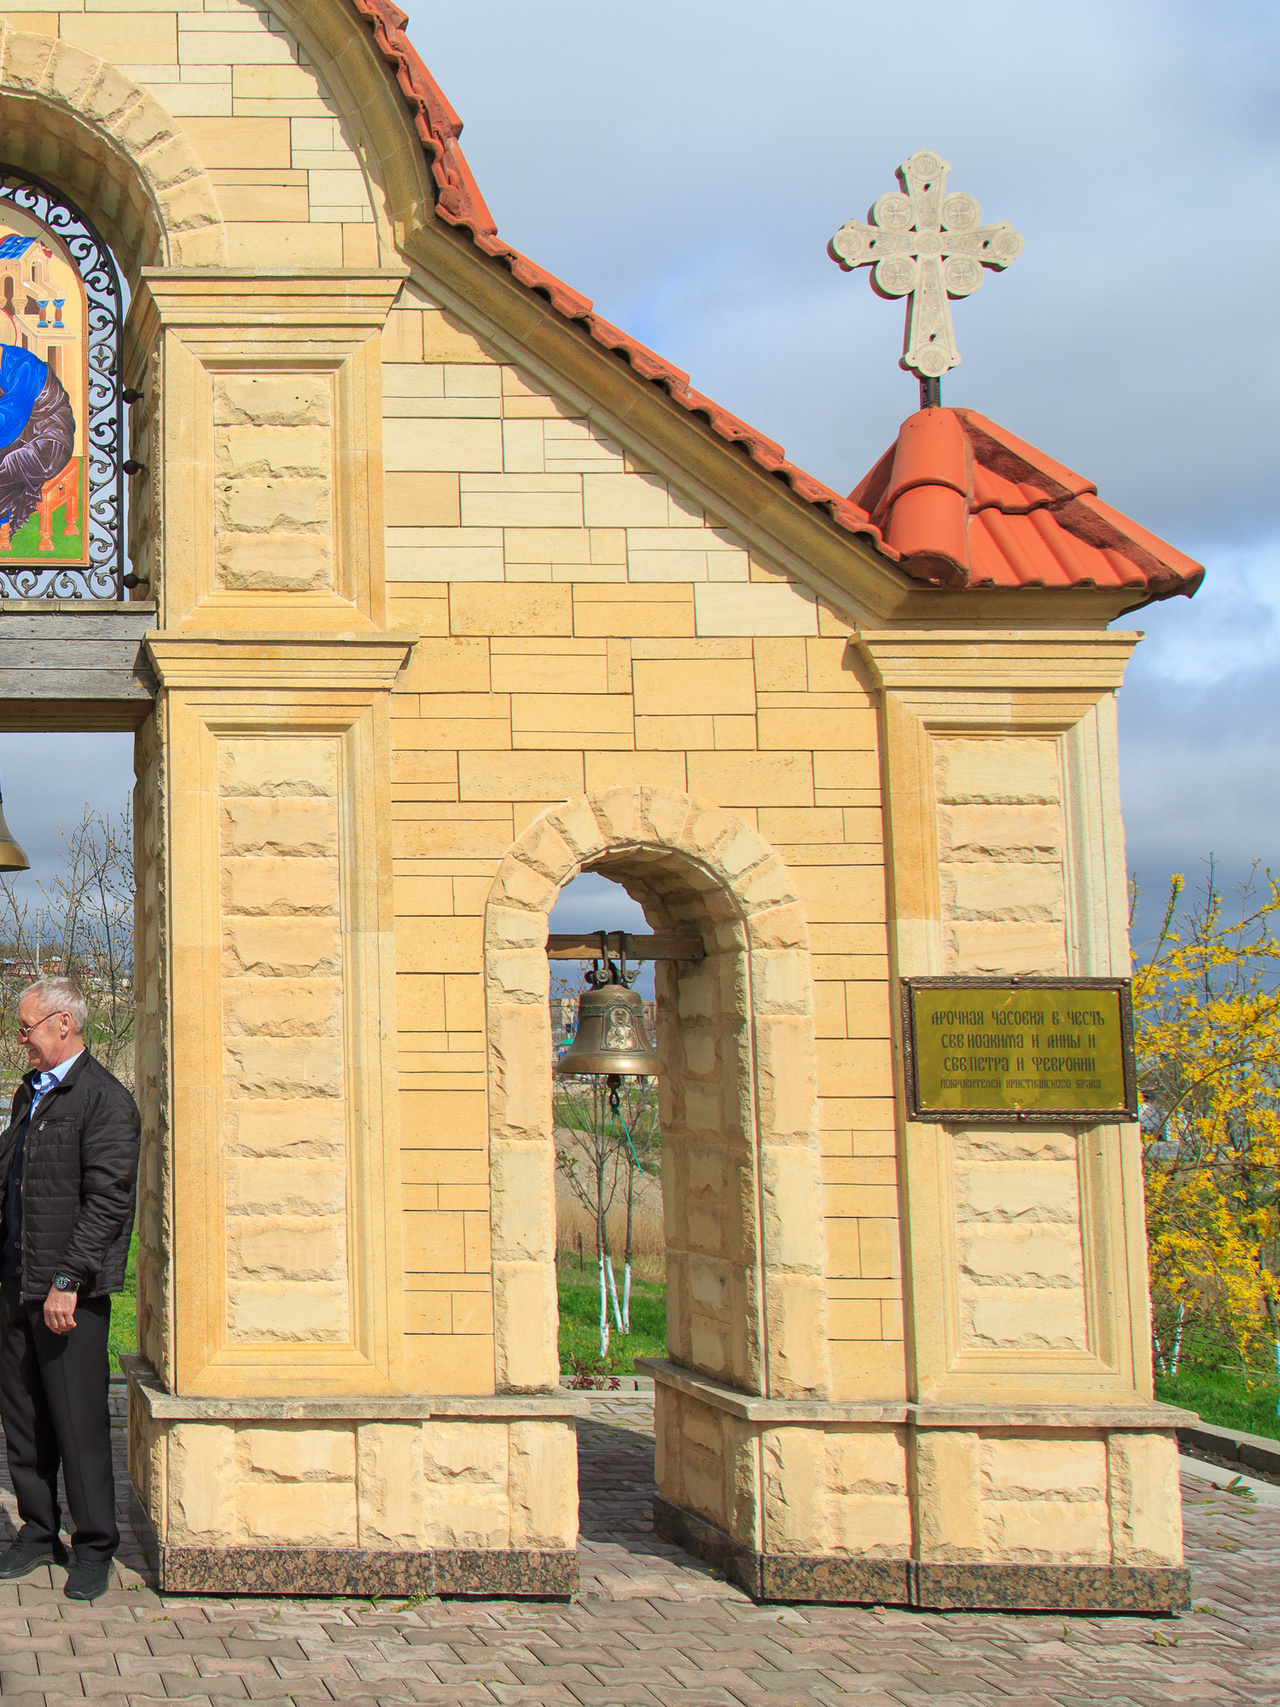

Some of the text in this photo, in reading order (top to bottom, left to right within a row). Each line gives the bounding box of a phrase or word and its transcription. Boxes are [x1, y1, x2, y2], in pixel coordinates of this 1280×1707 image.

[1031, 1033, 1039, 1049] И
[1088, 1033, 1096, 1049] И
[1016, 1056, 1024, 1072] И
